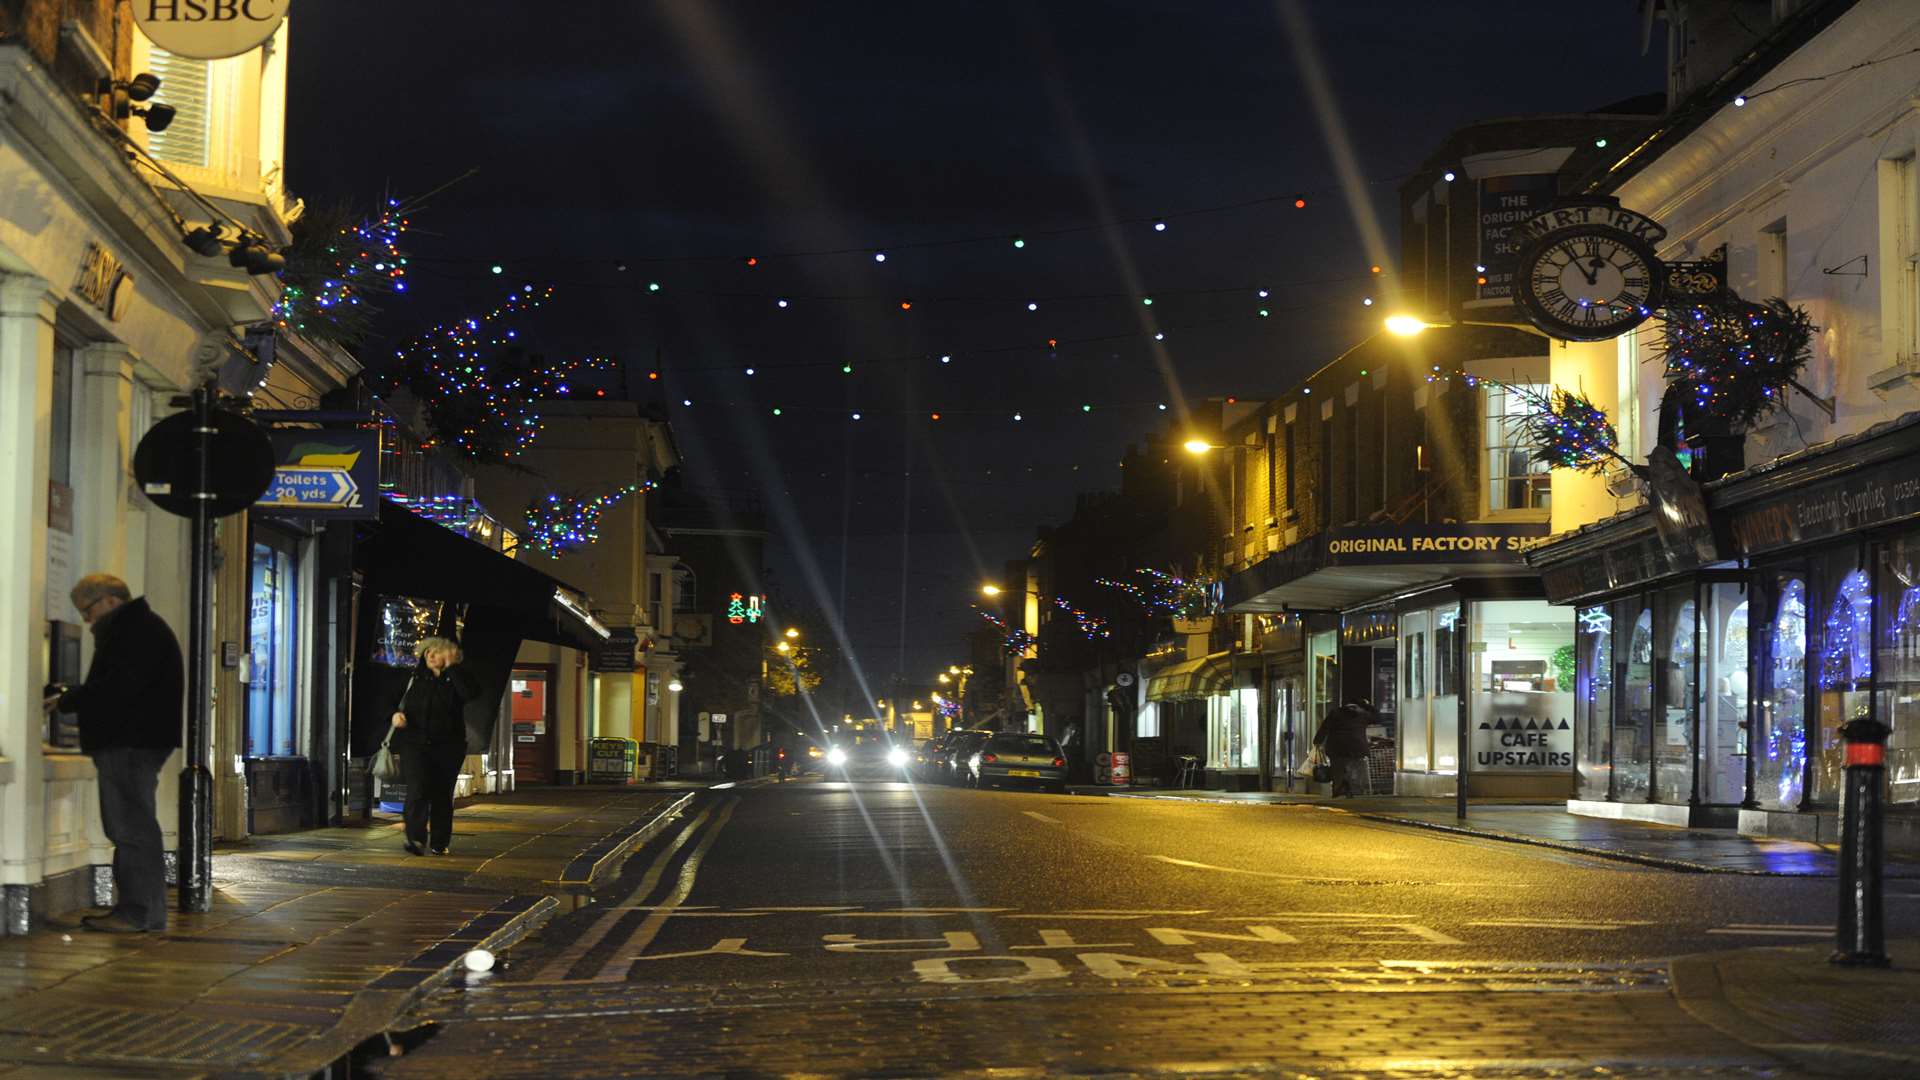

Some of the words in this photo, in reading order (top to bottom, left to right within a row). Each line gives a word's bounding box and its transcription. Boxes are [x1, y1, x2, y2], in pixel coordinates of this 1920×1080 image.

[145, 0, 275, 22] HSBC
[1500, 195, 1529, 207] THE
[1482, 210, 1541, 225] ORIGIN
[1482, 286, 1512, 297] FACTOR
[276, 474, 327, 486] Toilets
[275, 487, 296, 498] 20
[302, 488, 327, 500] yds
[1797, 489, 1841, 527] Electrical
[1841, 482, 1886, 522] Supplies
[1329, 537, 1407, 554] ORIGINAL
[1412, 536, 1501, 551] FACTORY
[1500, 732, 1549, 747] CAFE
[1478, 750, 1571, 767] UPSTAIRS
